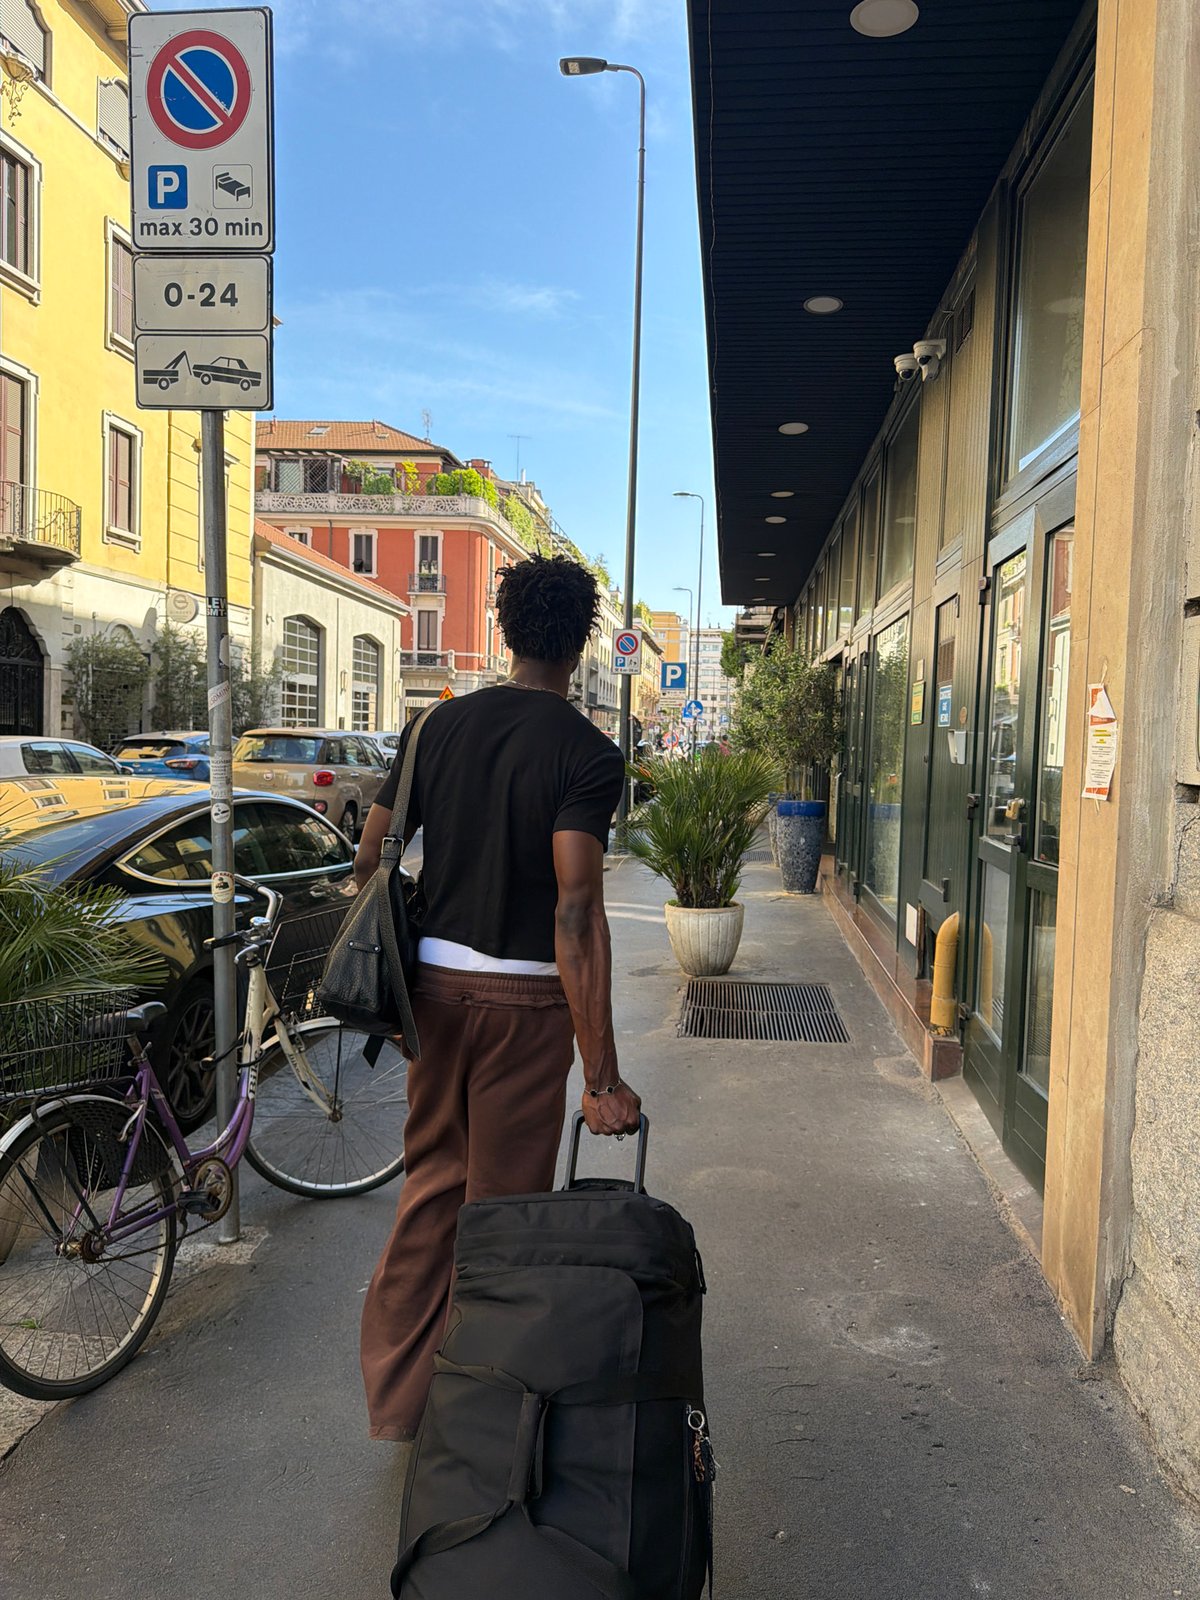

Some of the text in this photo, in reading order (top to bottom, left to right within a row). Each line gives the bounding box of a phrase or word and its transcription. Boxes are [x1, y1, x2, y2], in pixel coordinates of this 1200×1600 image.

[157, 171, 180, 204] P
[140, 217, 263, 236] max 30 min
[164, 282, 238, 307] 0-24
[617, 658, 624, 666] P
[665, 665, 682, 687] P
